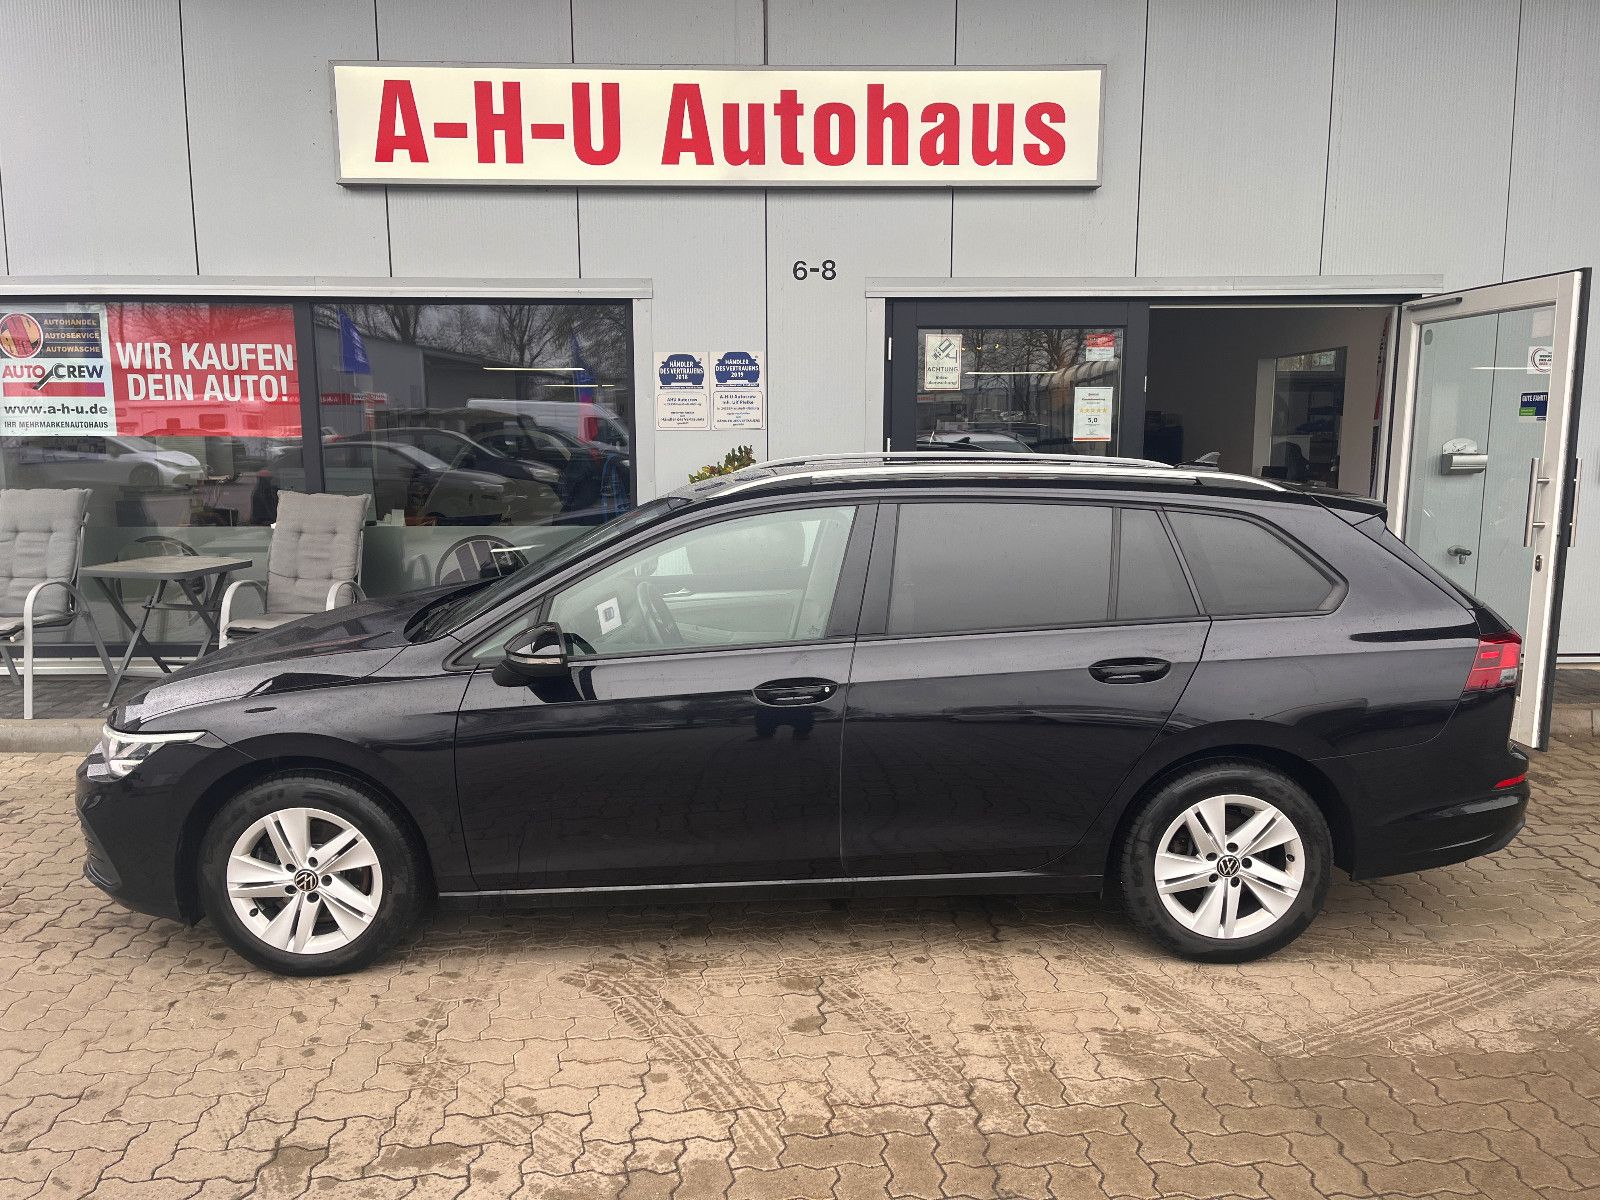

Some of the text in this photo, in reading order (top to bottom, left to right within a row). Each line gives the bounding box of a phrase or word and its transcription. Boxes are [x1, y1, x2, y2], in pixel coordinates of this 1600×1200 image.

[375, 79, 1066, 167] A-H-U Autohaus
[792, 259, 837, 281] 6-8
[43, 318, 97, 326] AUTOHANDEL
[115, 342, 294, 371] WIR KAUFEN
[126, 373, 289, 402] DEIN AUTO!
[4, 403, 108, 415] www.a-h-u.de
[4, 421, 109, 429] IHR MEHRMARKENAUTOHAUS
